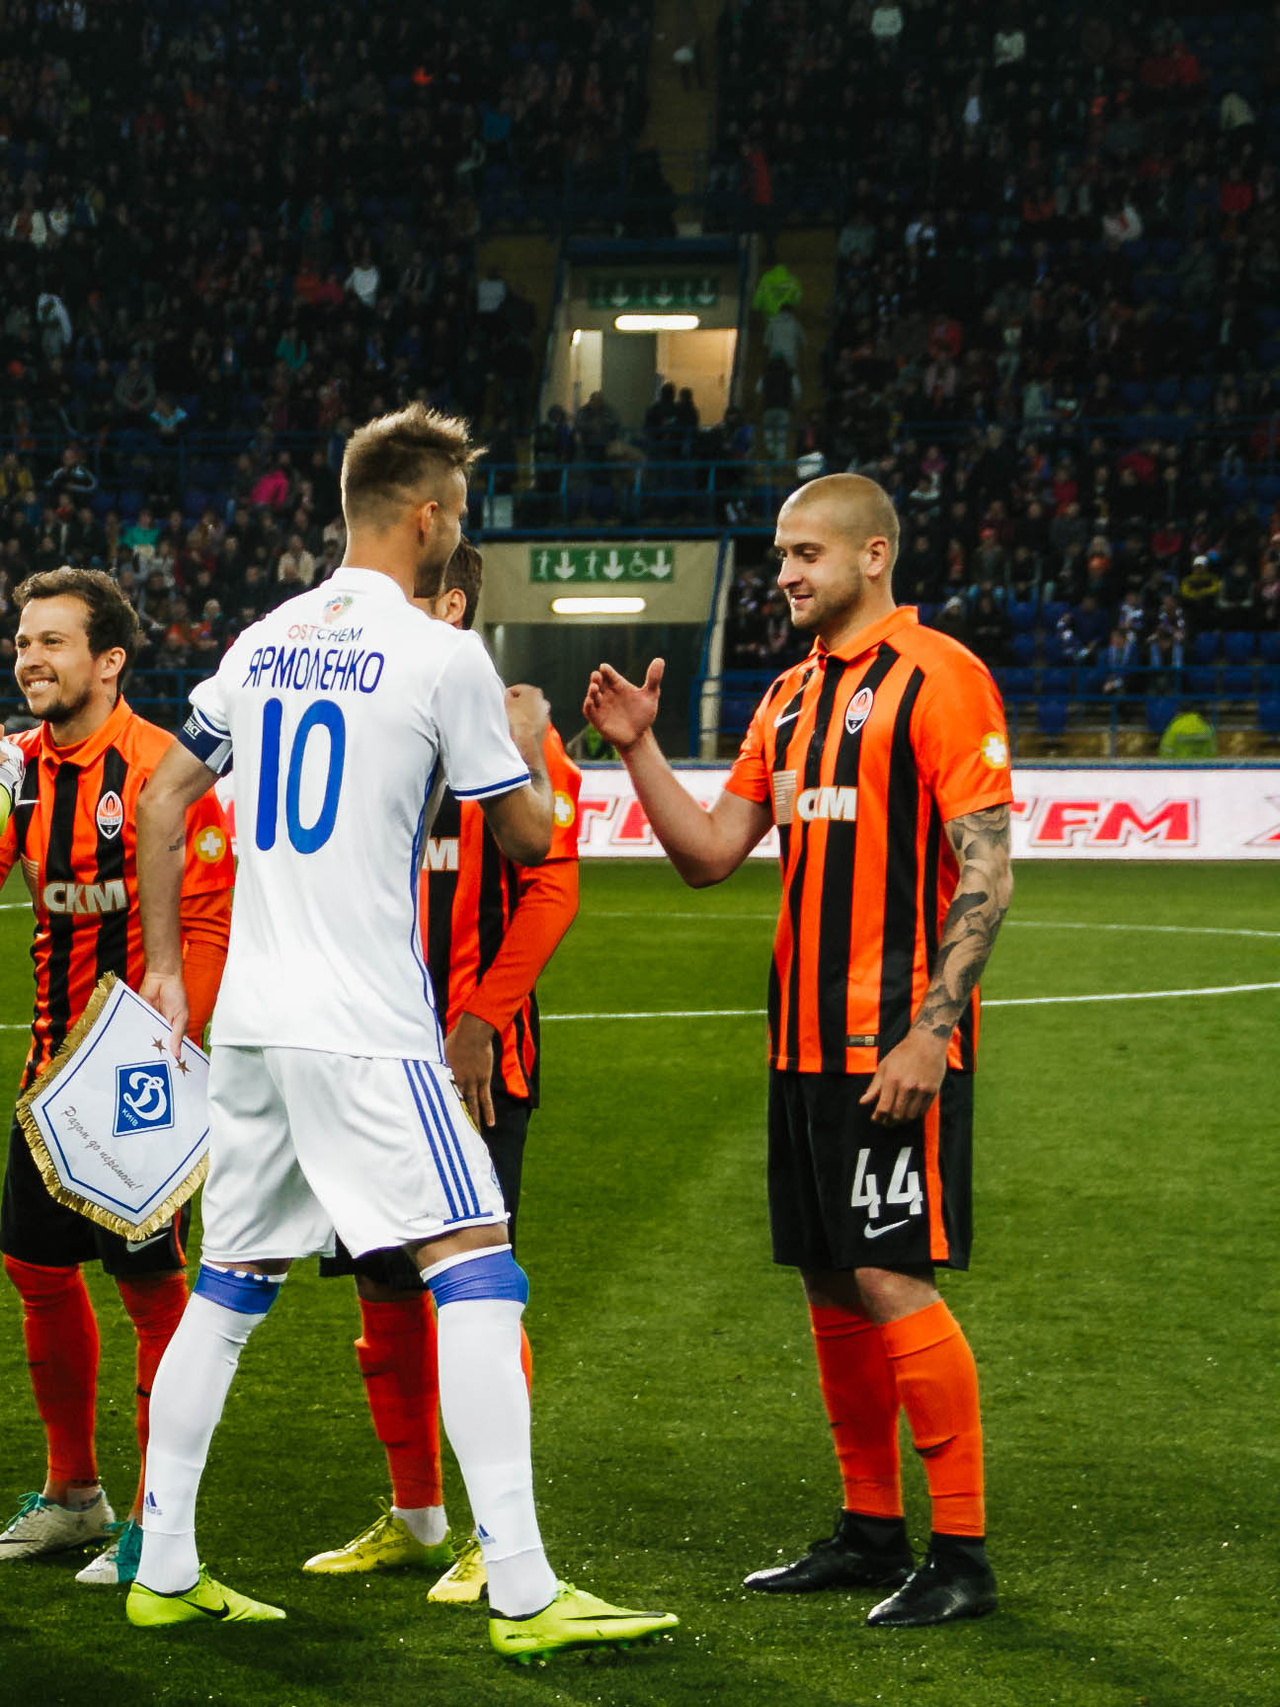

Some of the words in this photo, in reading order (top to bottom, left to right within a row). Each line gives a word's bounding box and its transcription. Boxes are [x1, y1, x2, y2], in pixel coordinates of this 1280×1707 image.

[288, 624, 363, 642] OSTCHEM
[241, 645, 385, 694] ЯРМОЛЕНКО
[255, 697, 346, 855] 10
[43, 880, 127, 914] СКМ
[851, 1147, 923, 1218] 44
